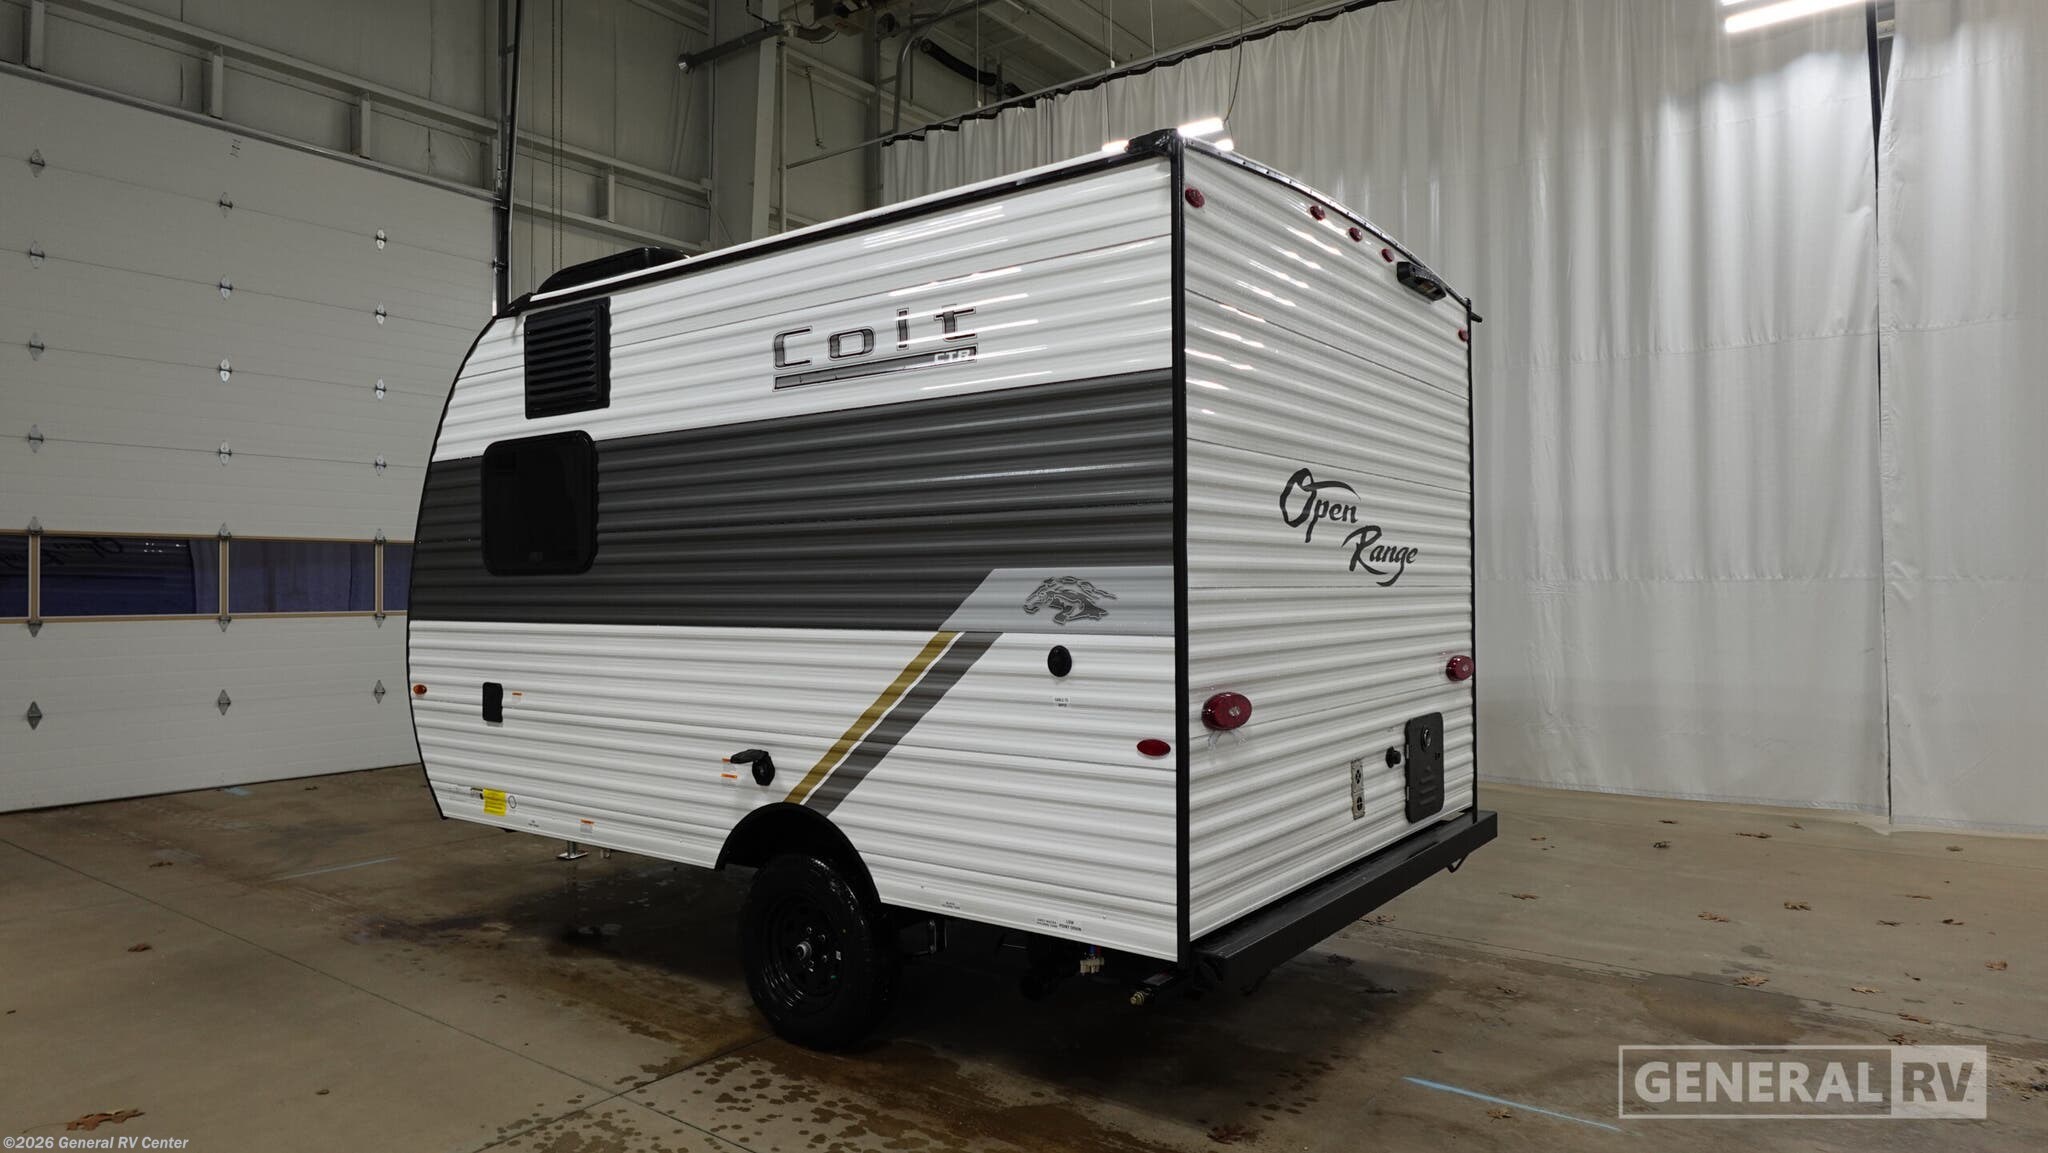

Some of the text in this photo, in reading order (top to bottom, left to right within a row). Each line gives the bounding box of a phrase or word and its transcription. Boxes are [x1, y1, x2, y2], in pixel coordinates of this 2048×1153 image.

[773, 304, 977, 370] Colt
[1279, 467, 1361, 544] Open
[1341, 525, 1419, 587] Range
